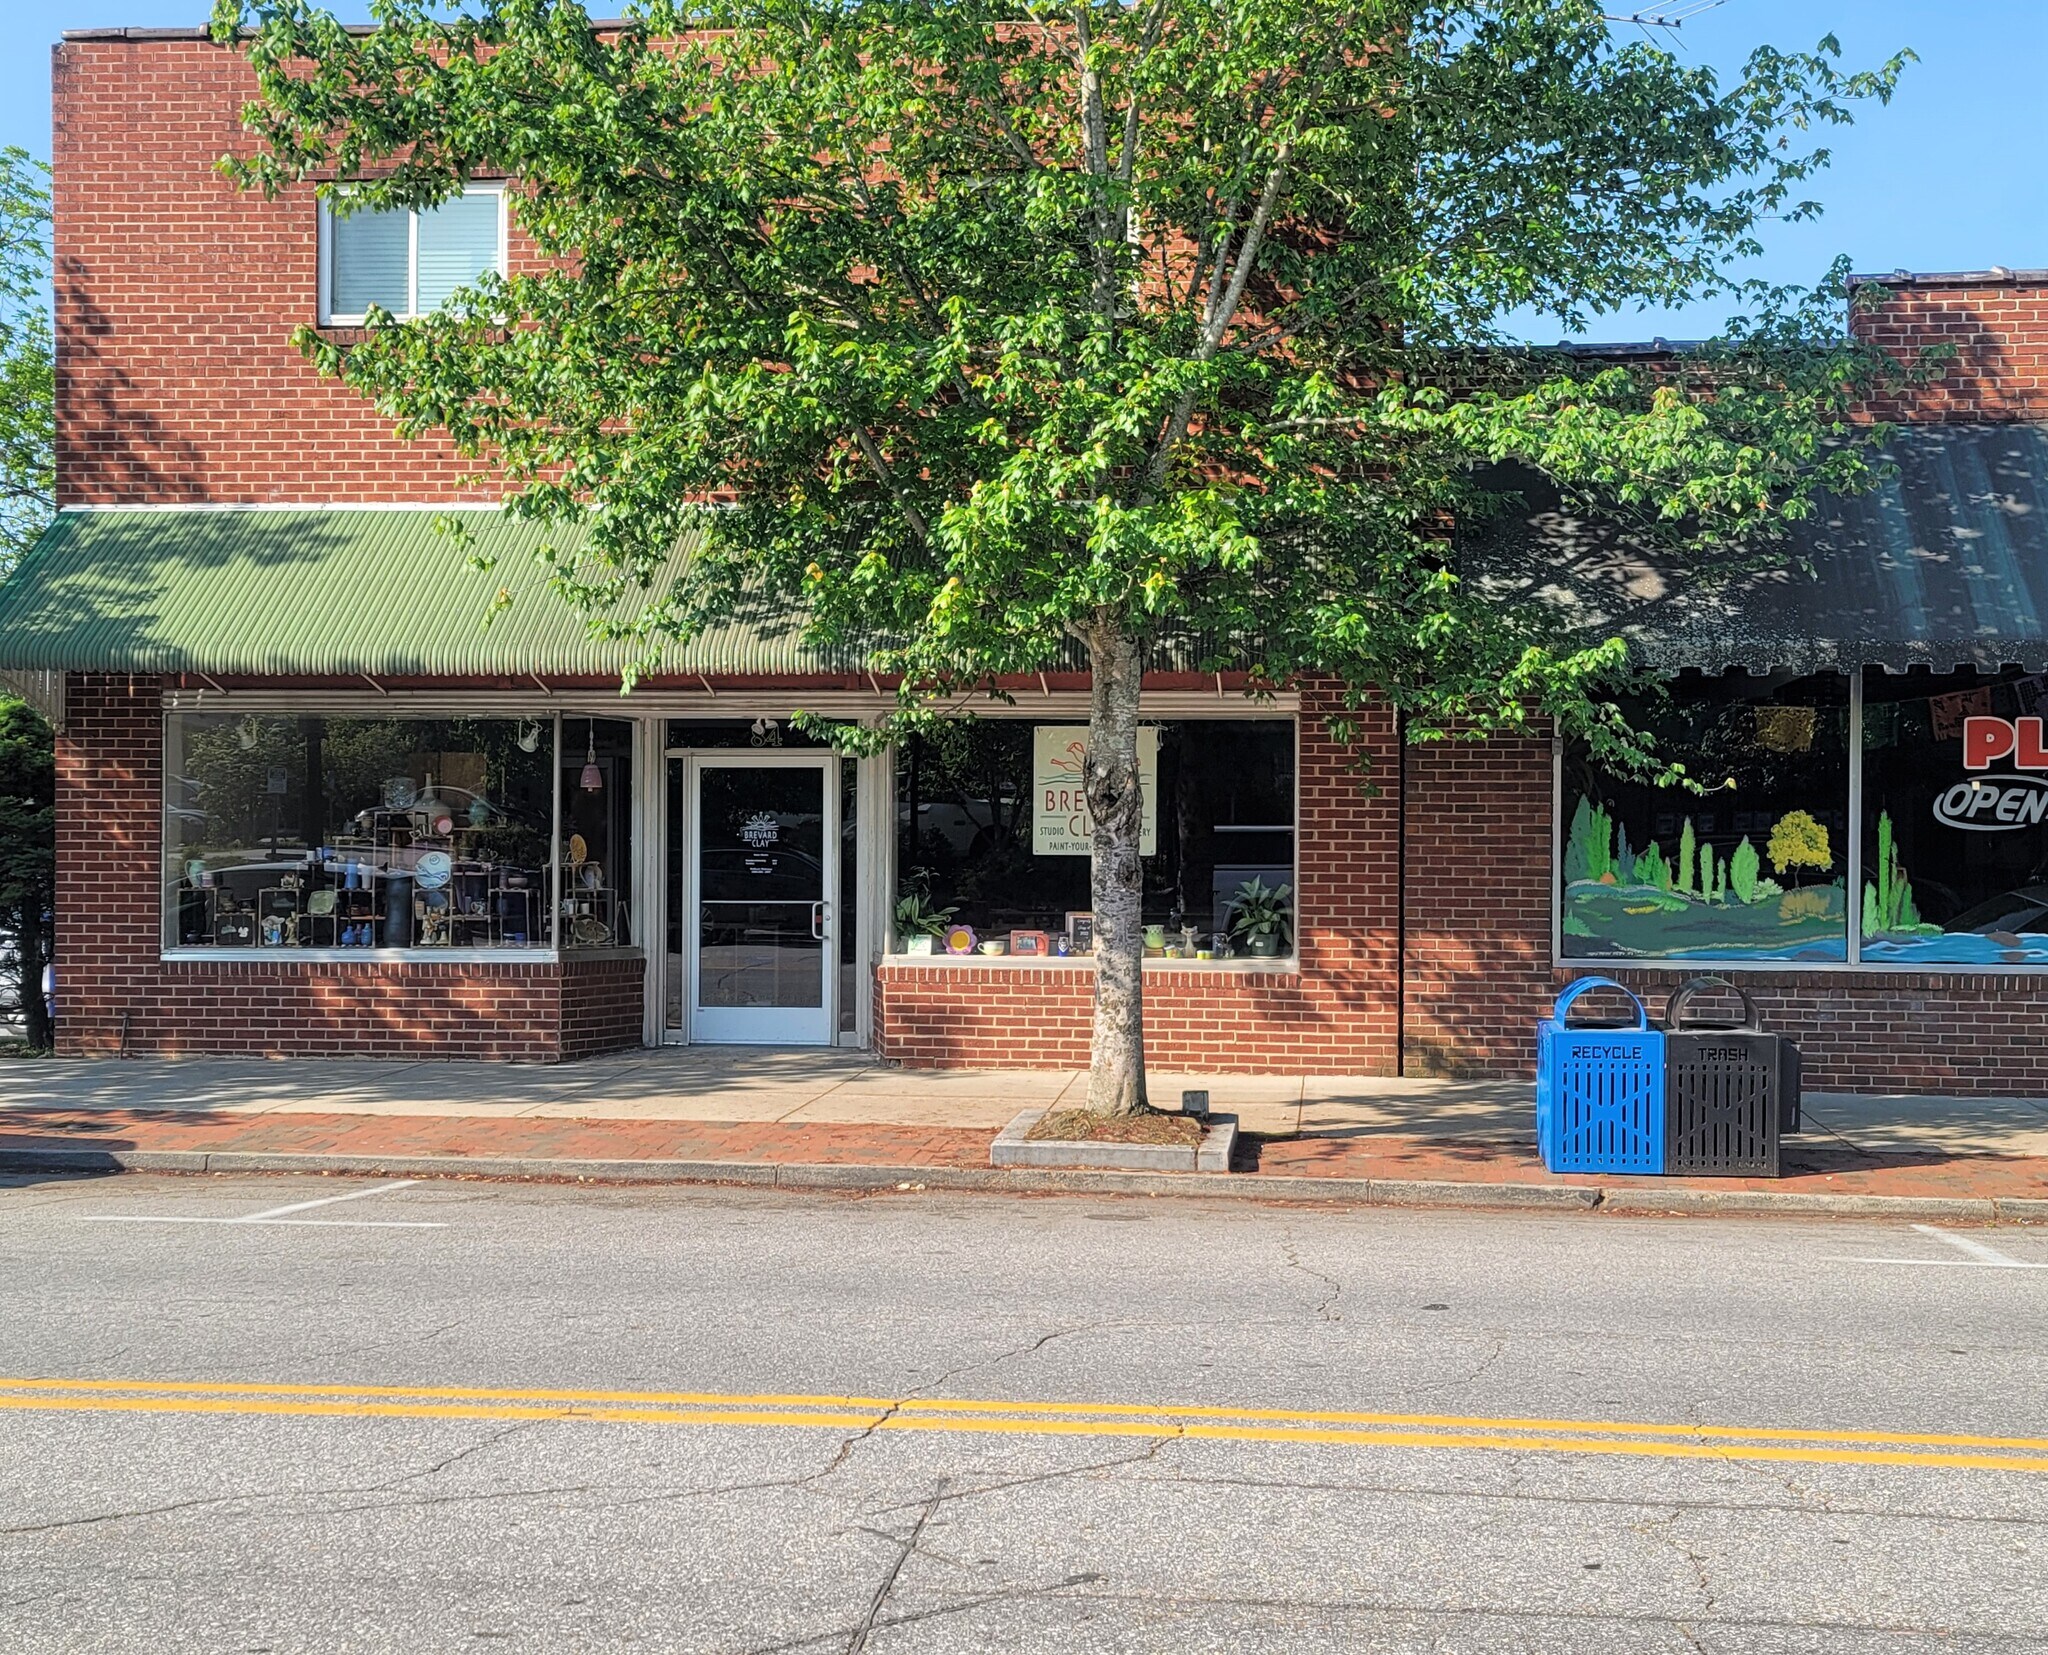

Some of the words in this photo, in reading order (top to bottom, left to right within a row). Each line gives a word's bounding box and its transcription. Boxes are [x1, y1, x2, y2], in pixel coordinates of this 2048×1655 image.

[1963, 716, 2048, 770] PL
[1942, 783, 2048, 824] OPEN
[1040, 826, 1065, 836] STUDIO
[1069, 815, 1091, 837] CL
[744, 830, 778, 839] BREVARD
[751, 839, 769, 848] CLAY
[1049, 841, 1092, 851] PAINT-YOUR-
[1572, 1046, 1642, 1059] RECYCLE
[1698, 1047, 1748, 1061] TRASH
